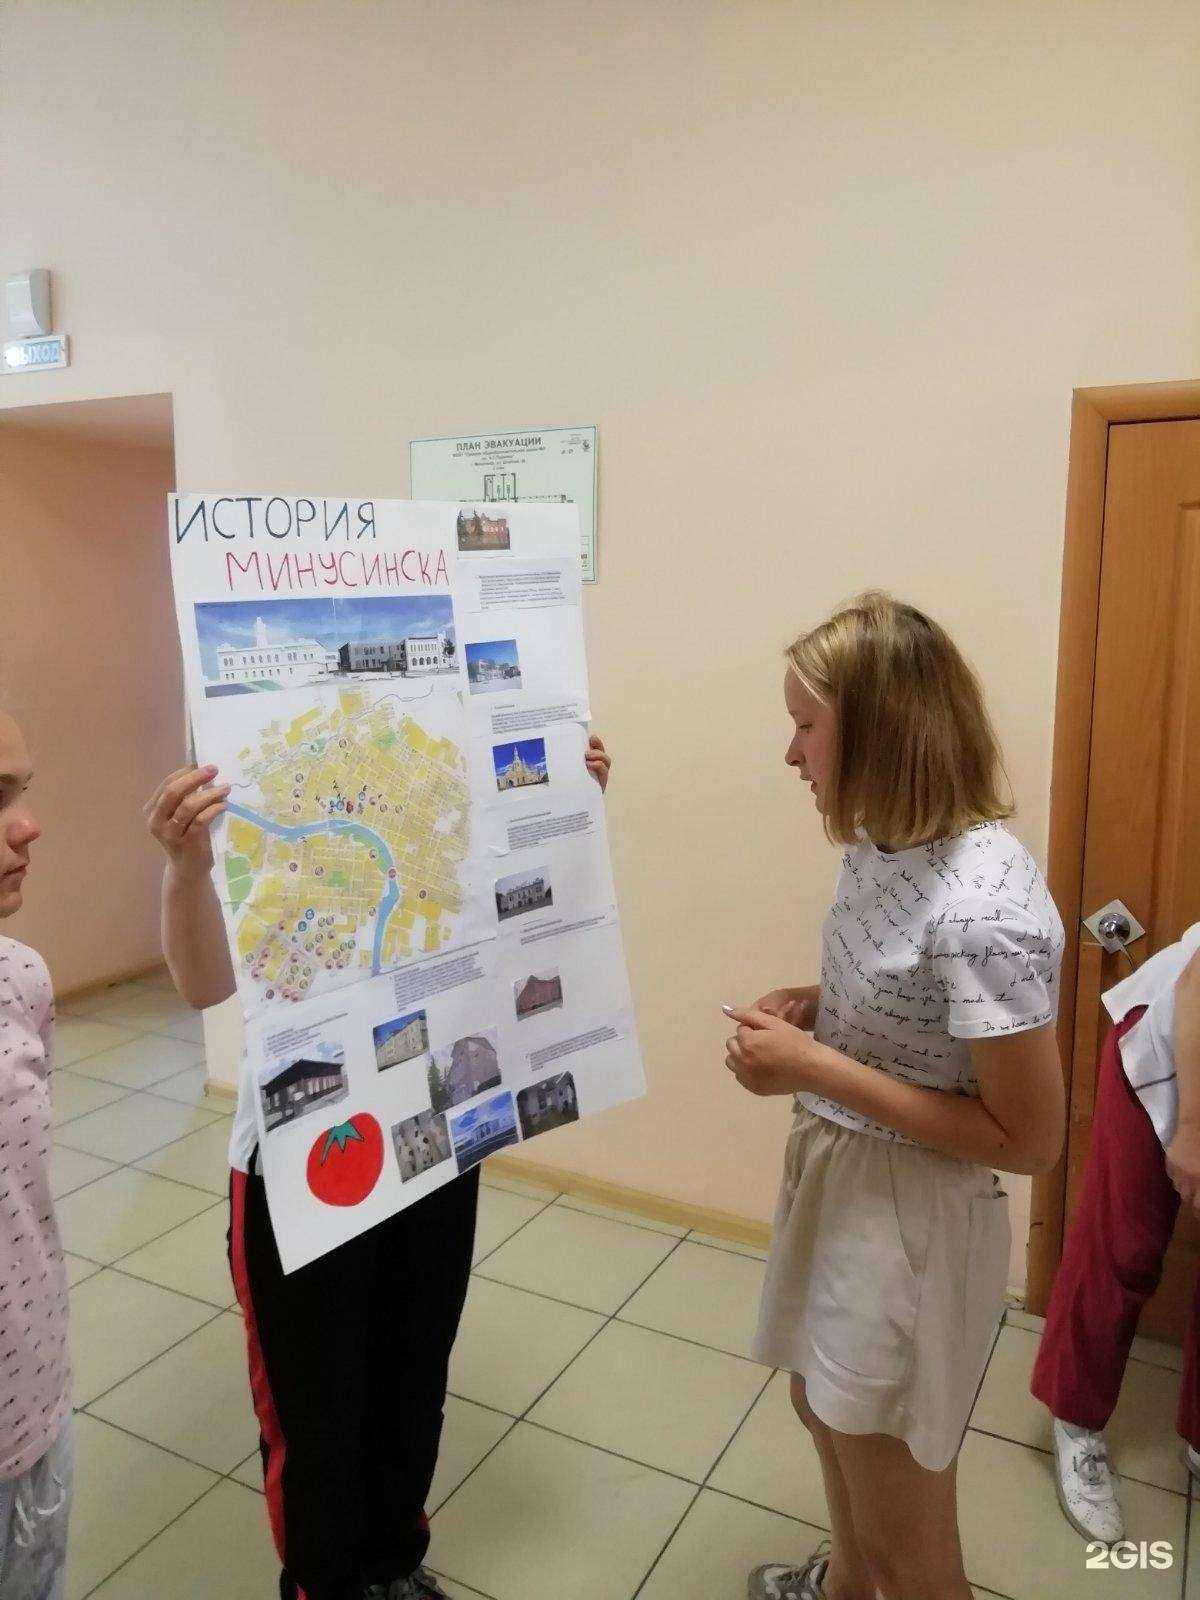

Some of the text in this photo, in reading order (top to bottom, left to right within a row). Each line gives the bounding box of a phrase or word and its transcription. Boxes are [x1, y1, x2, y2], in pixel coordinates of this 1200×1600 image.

[456, 442, 480, 452] ПЛАН
[484, 437, 542, 449] ЭВАКУАЦИИ
[174, 497, 377, 544] ИСТОРИЯ
[225, 550, 449, 590] МИНУСИНСКА
